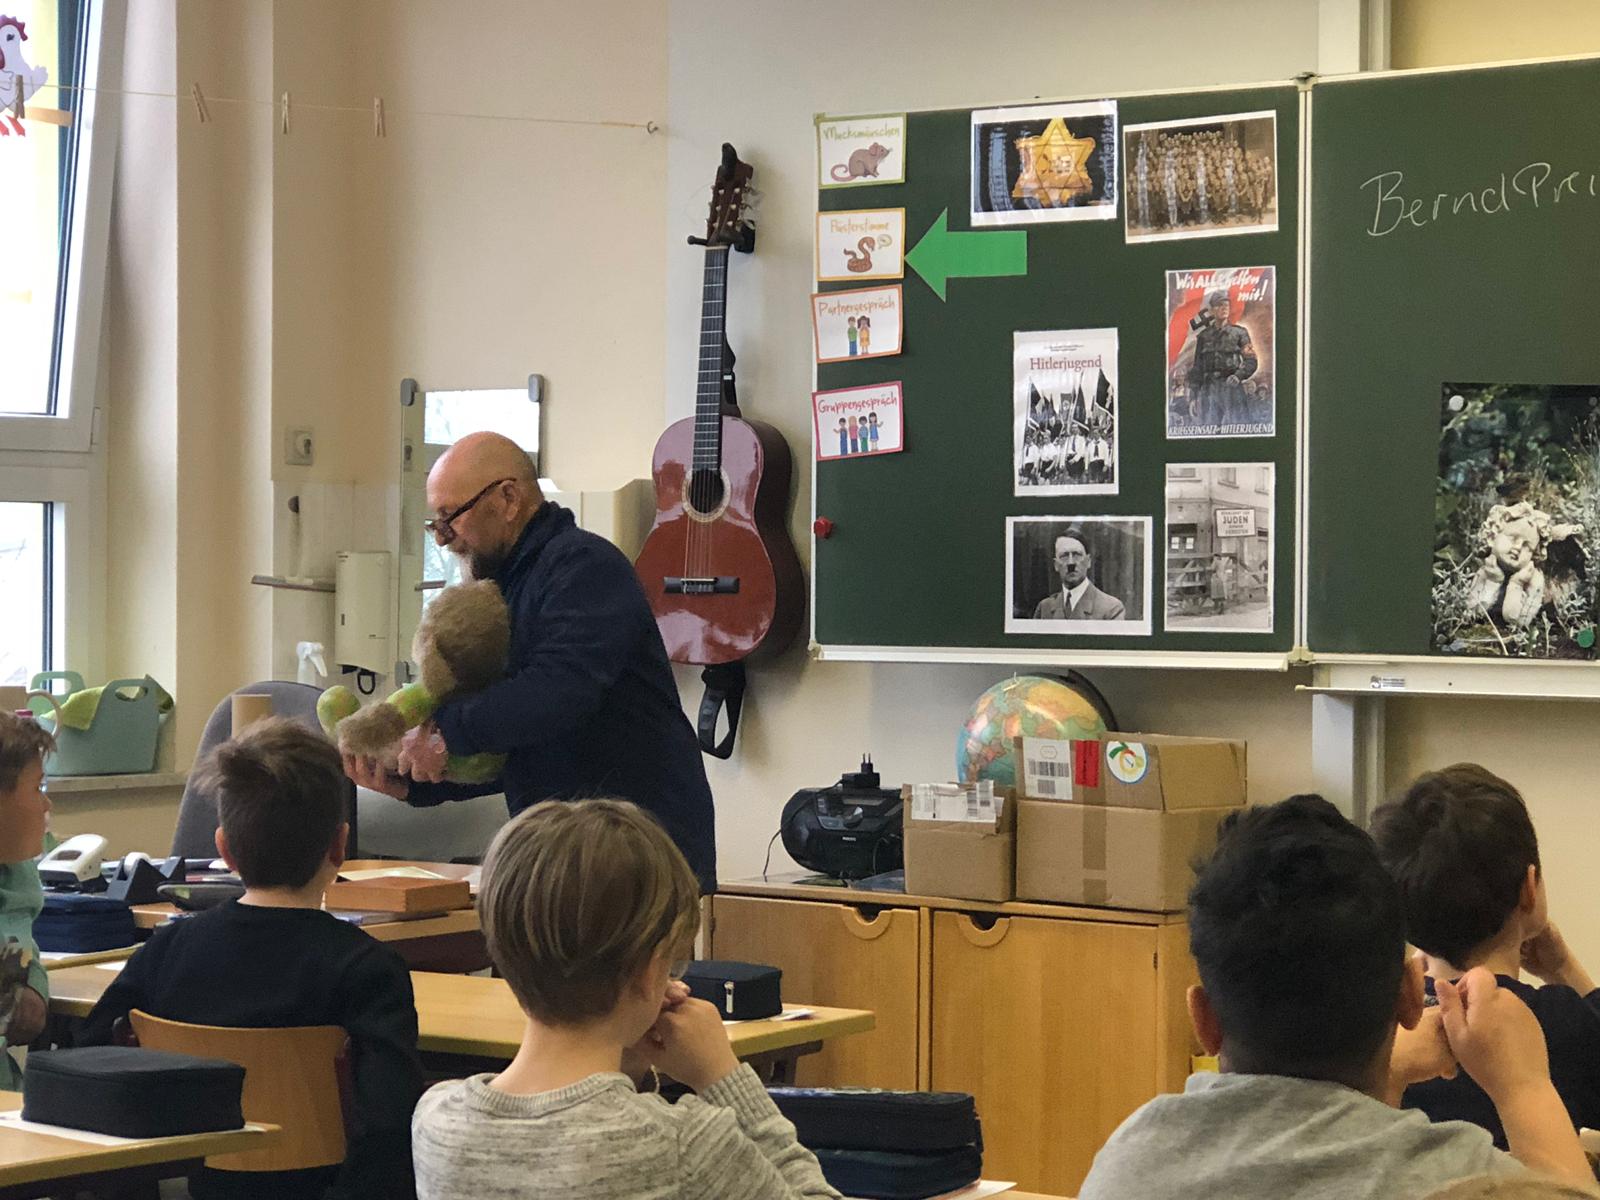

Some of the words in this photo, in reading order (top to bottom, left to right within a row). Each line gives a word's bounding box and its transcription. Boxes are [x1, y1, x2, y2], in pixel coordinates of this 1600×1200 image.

[1360, 171, 1510, 236] Bernd
[818, 295, 896, 318] Partnergespräch
[1030, 355, 1102, 372] Hitlerjugend
[818, 391, 898, 414] Gruppengespräch
[1220, 423, 1275, 435] HITLERJUGEND
[1222, 515, 1248, 524] JUDEN
